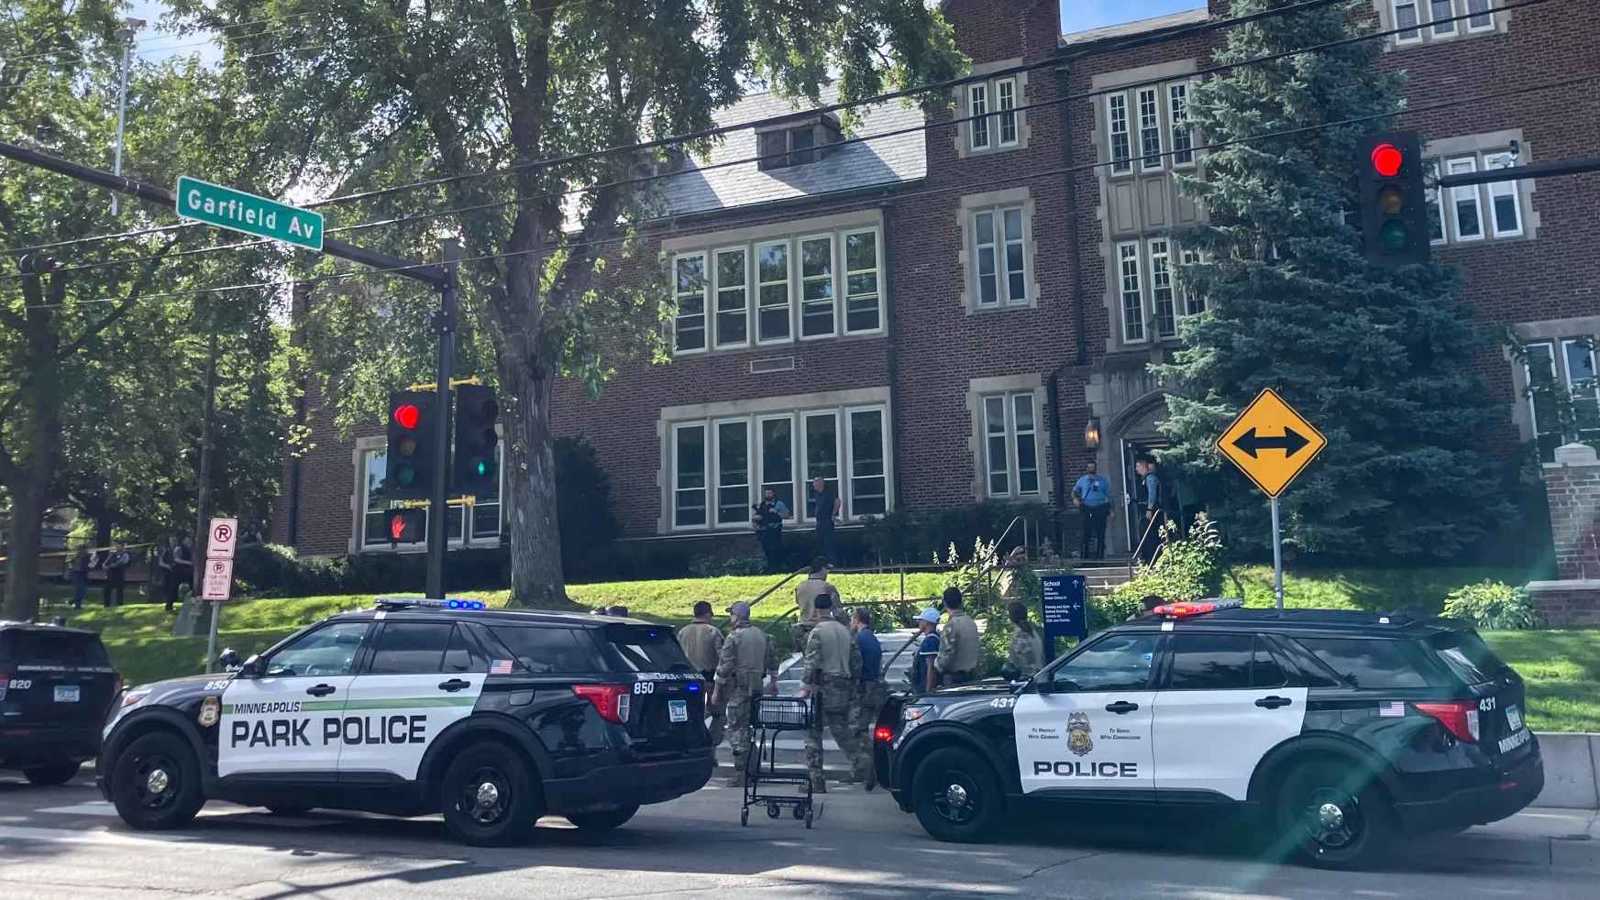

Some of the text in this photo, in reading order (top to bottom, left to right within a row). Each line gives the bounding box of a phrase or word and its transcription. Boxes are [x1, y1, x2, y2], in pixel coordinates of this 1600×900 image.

[187, 189, 314, 239] Garfield Av
[9, 679, 32, 689] 820
[204, 680, 230, 690] 850
[633, 681, 655, 695] 850
[233, 701, 301, 714] MINNEAPOLIS
[990, 697, 1016, 708] 431
[1479, 696, 1496, 712] 431
[231, 714, 428, 748] PARK POLICE
[1033, 761, 1138, 778] POLICE
